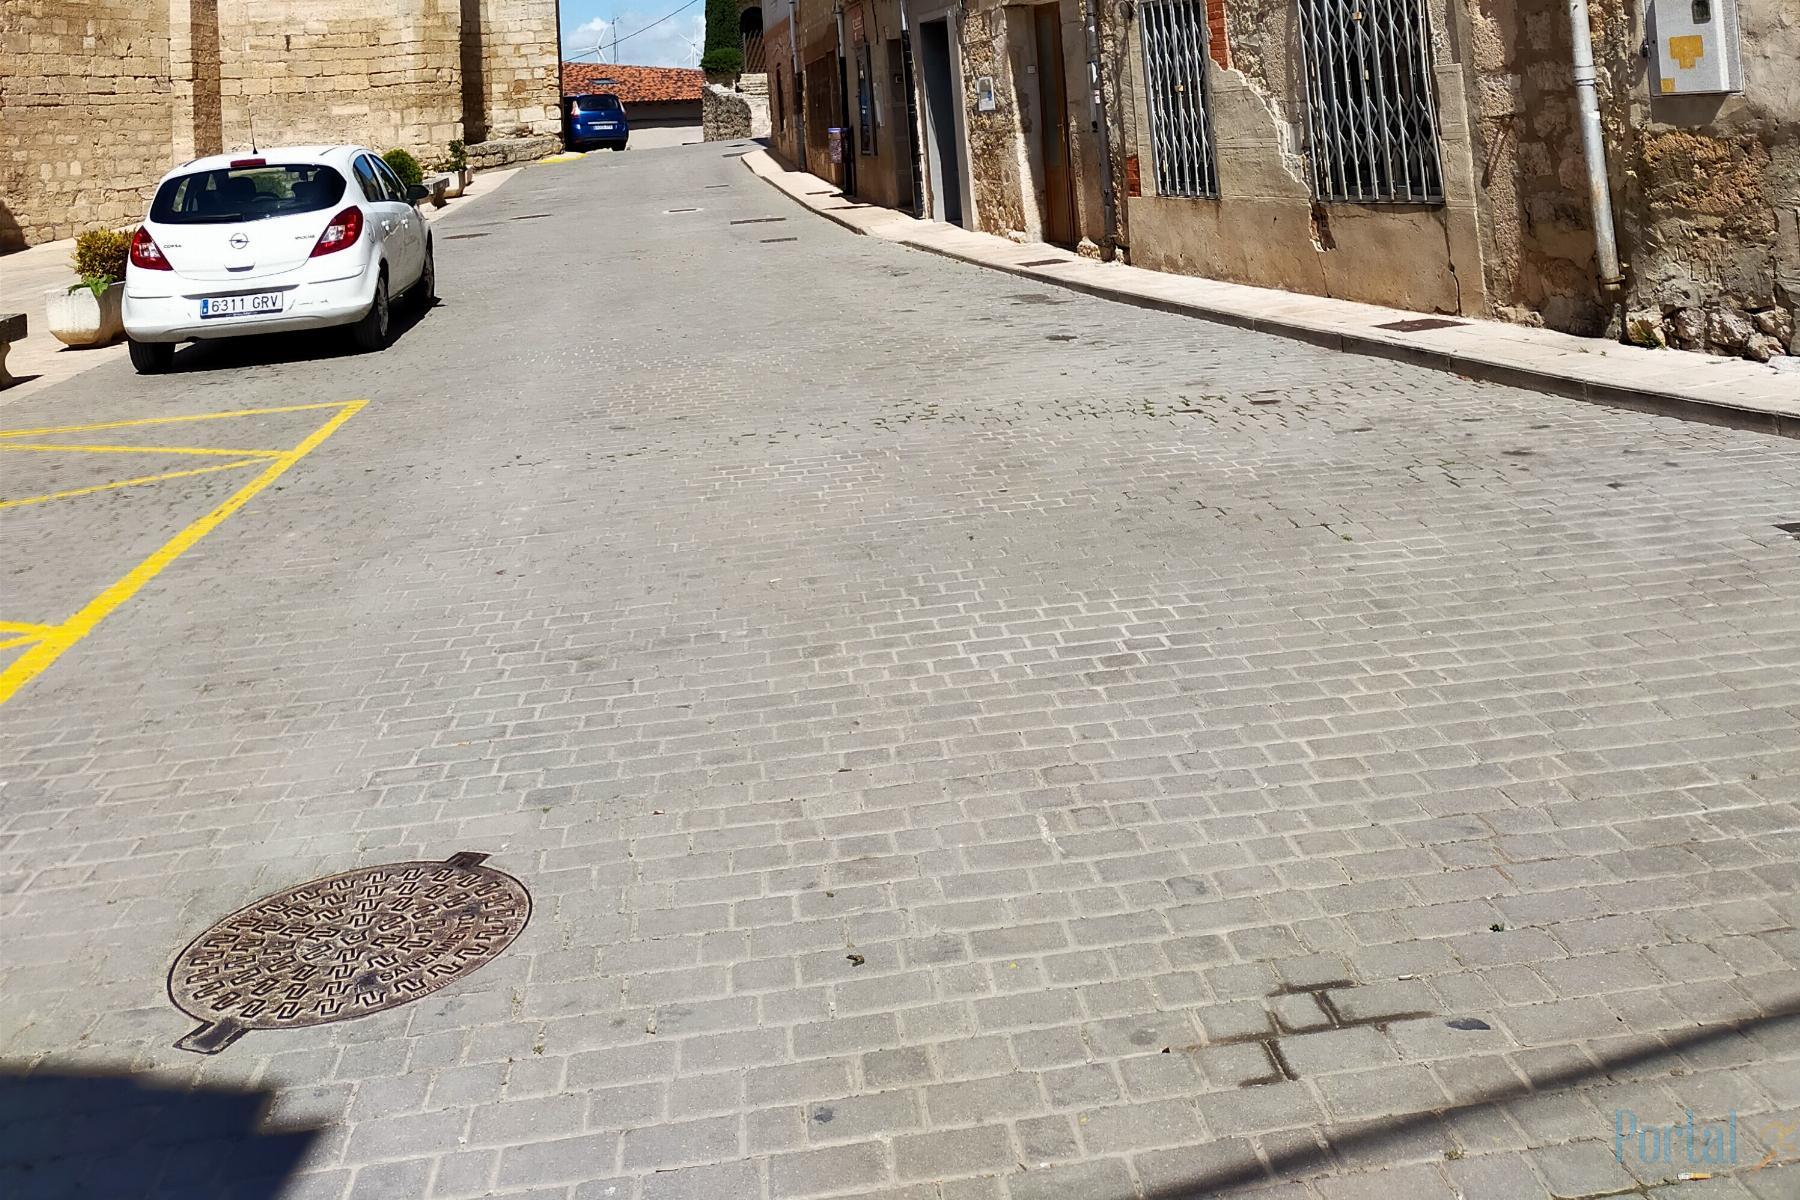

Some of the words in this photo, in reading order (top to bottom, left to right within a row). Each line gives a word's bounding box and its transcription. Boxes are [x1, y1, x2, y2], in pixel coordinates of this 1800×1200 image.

[211, 298, 245, 312] 6311
[252, 294, 278, 309] GRV
[379, 912, 477, 982] SANEAMIENTO
